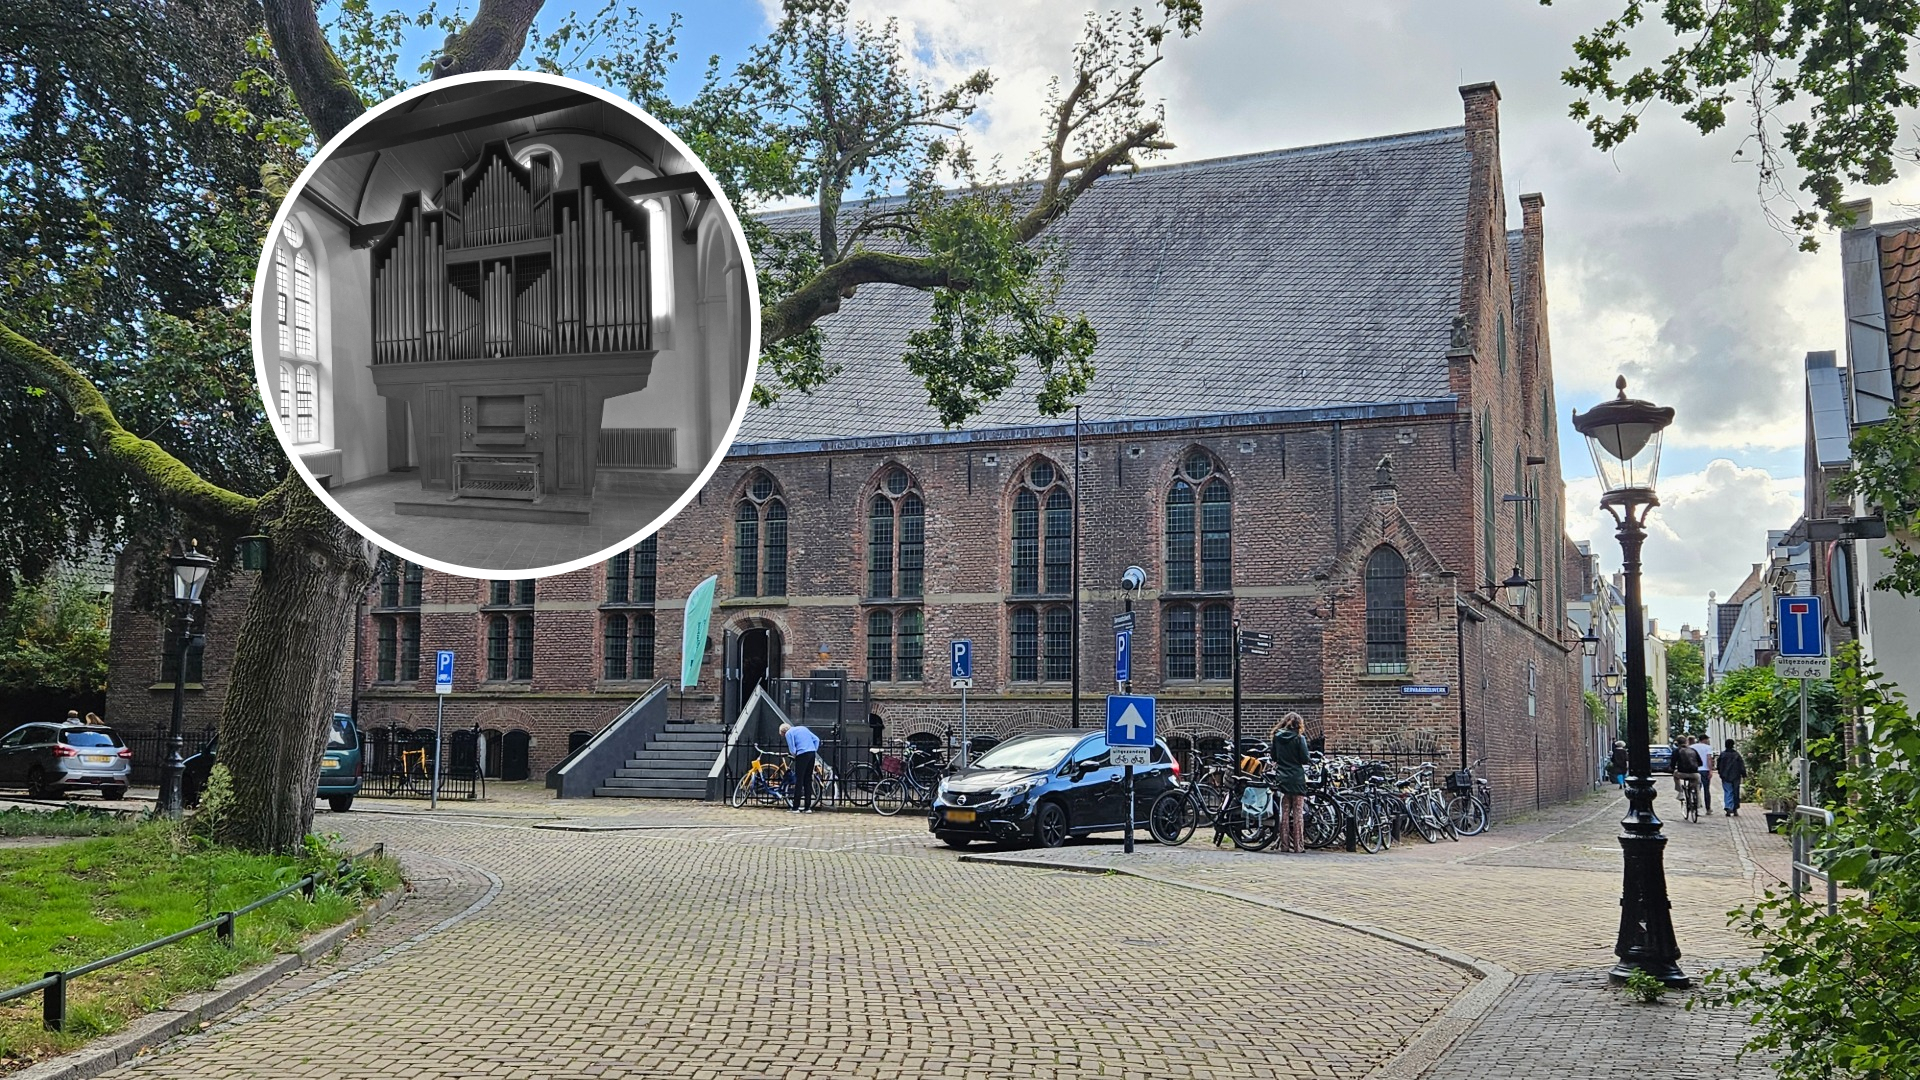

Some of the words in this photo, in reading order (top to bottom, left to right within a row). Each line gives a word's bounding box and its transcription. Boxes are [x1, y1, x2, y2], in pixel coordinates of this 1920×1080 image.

[954, 643, 966, 663] P
[1118, 636, 1125, 661] P
[440, 654, 450, 671] P
